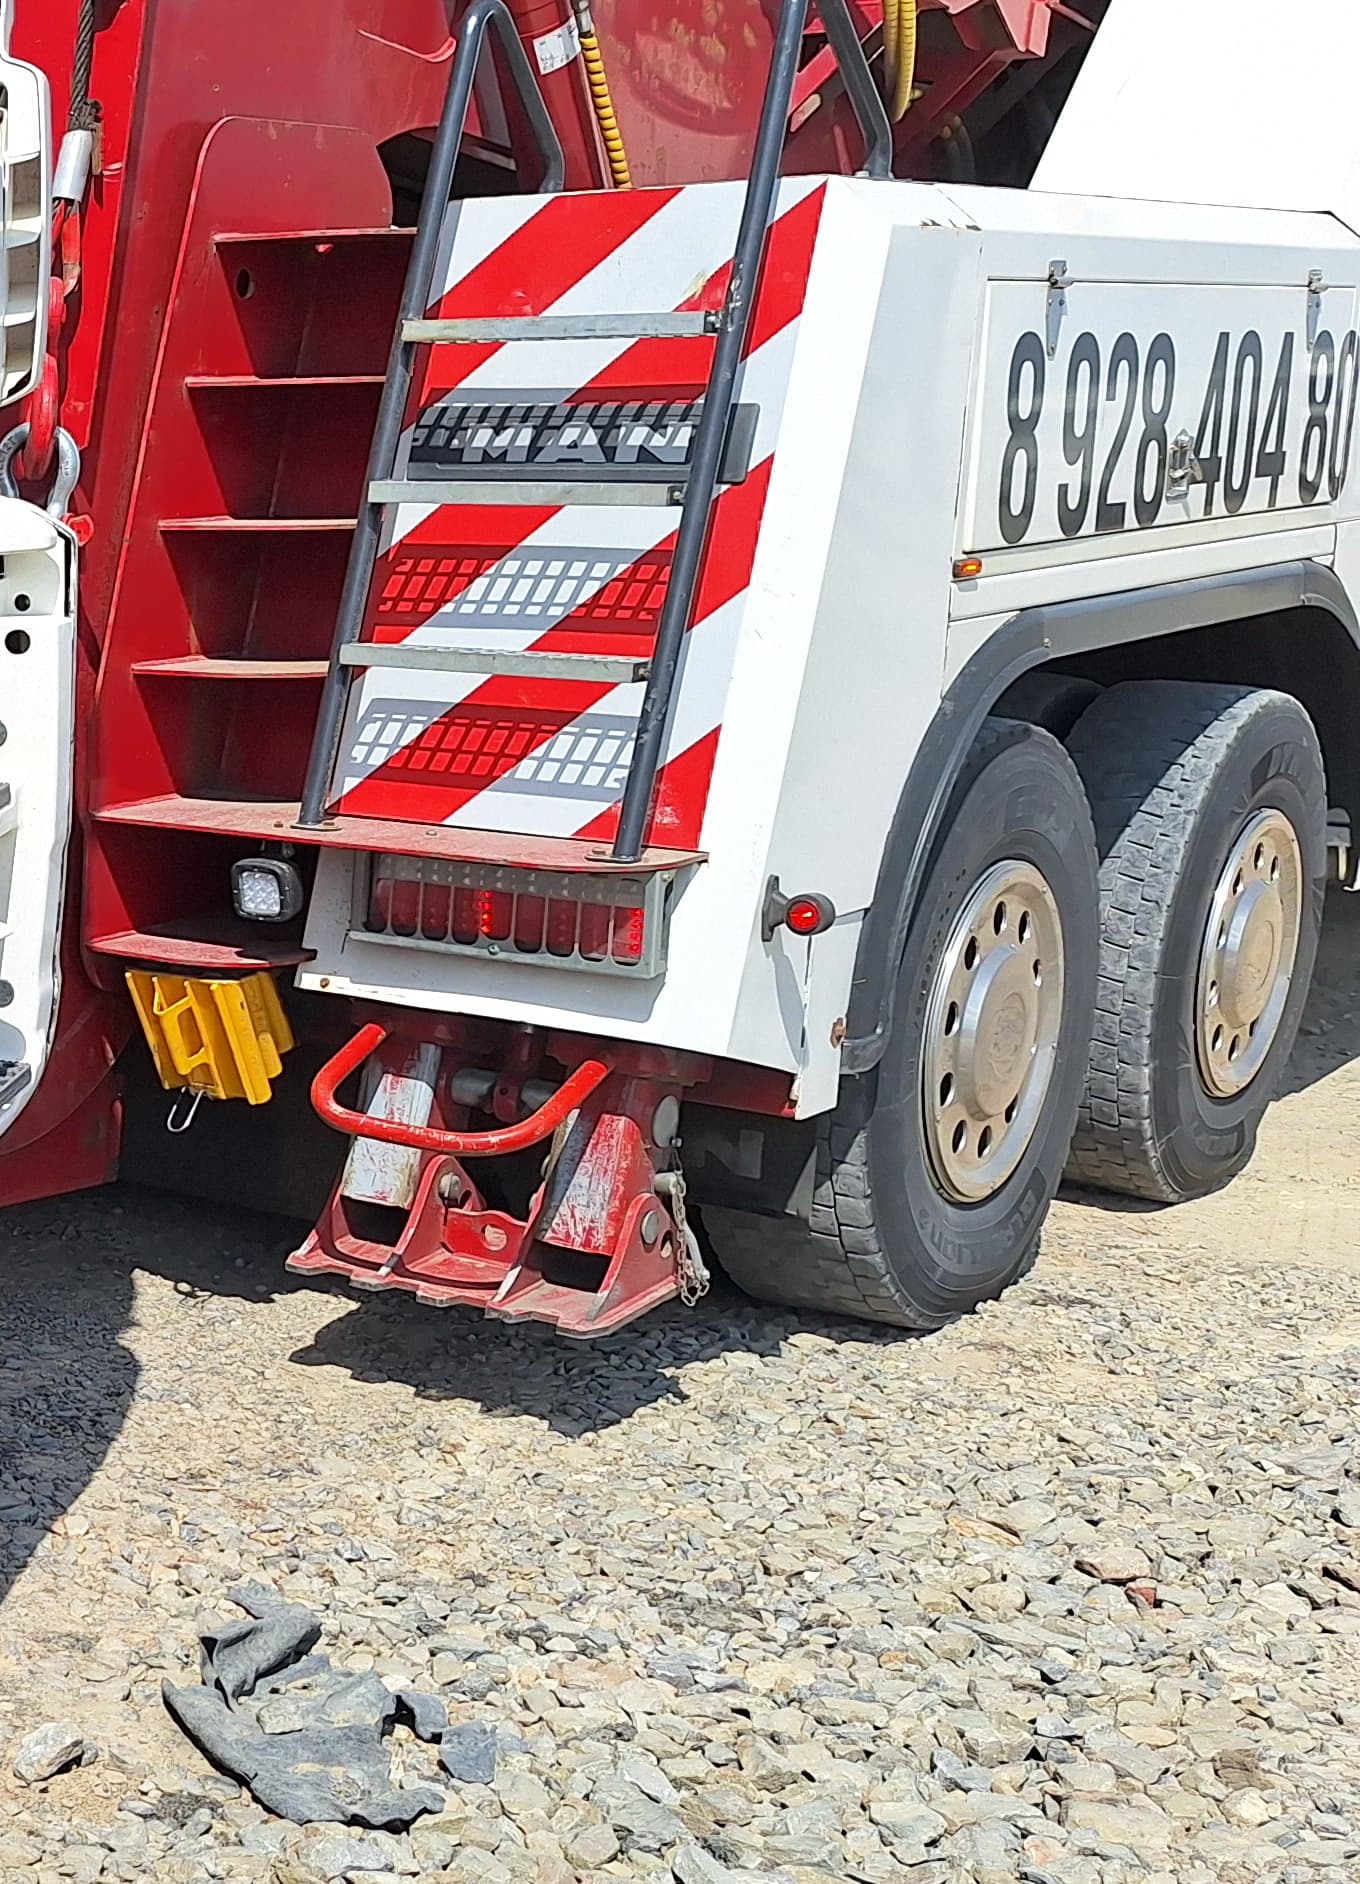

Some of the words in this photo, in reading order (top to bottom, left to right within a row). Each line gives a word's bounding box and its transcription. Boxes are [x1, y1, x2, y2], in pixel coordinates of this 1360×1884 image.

[461, 420, 694, 463] MAN
[998, 330, 1046, 545] 8
[1057, 330, 1177, 538] 928
[1188, 330, 1295, 517] 404
[1298, 329, 1360, 505] 80
